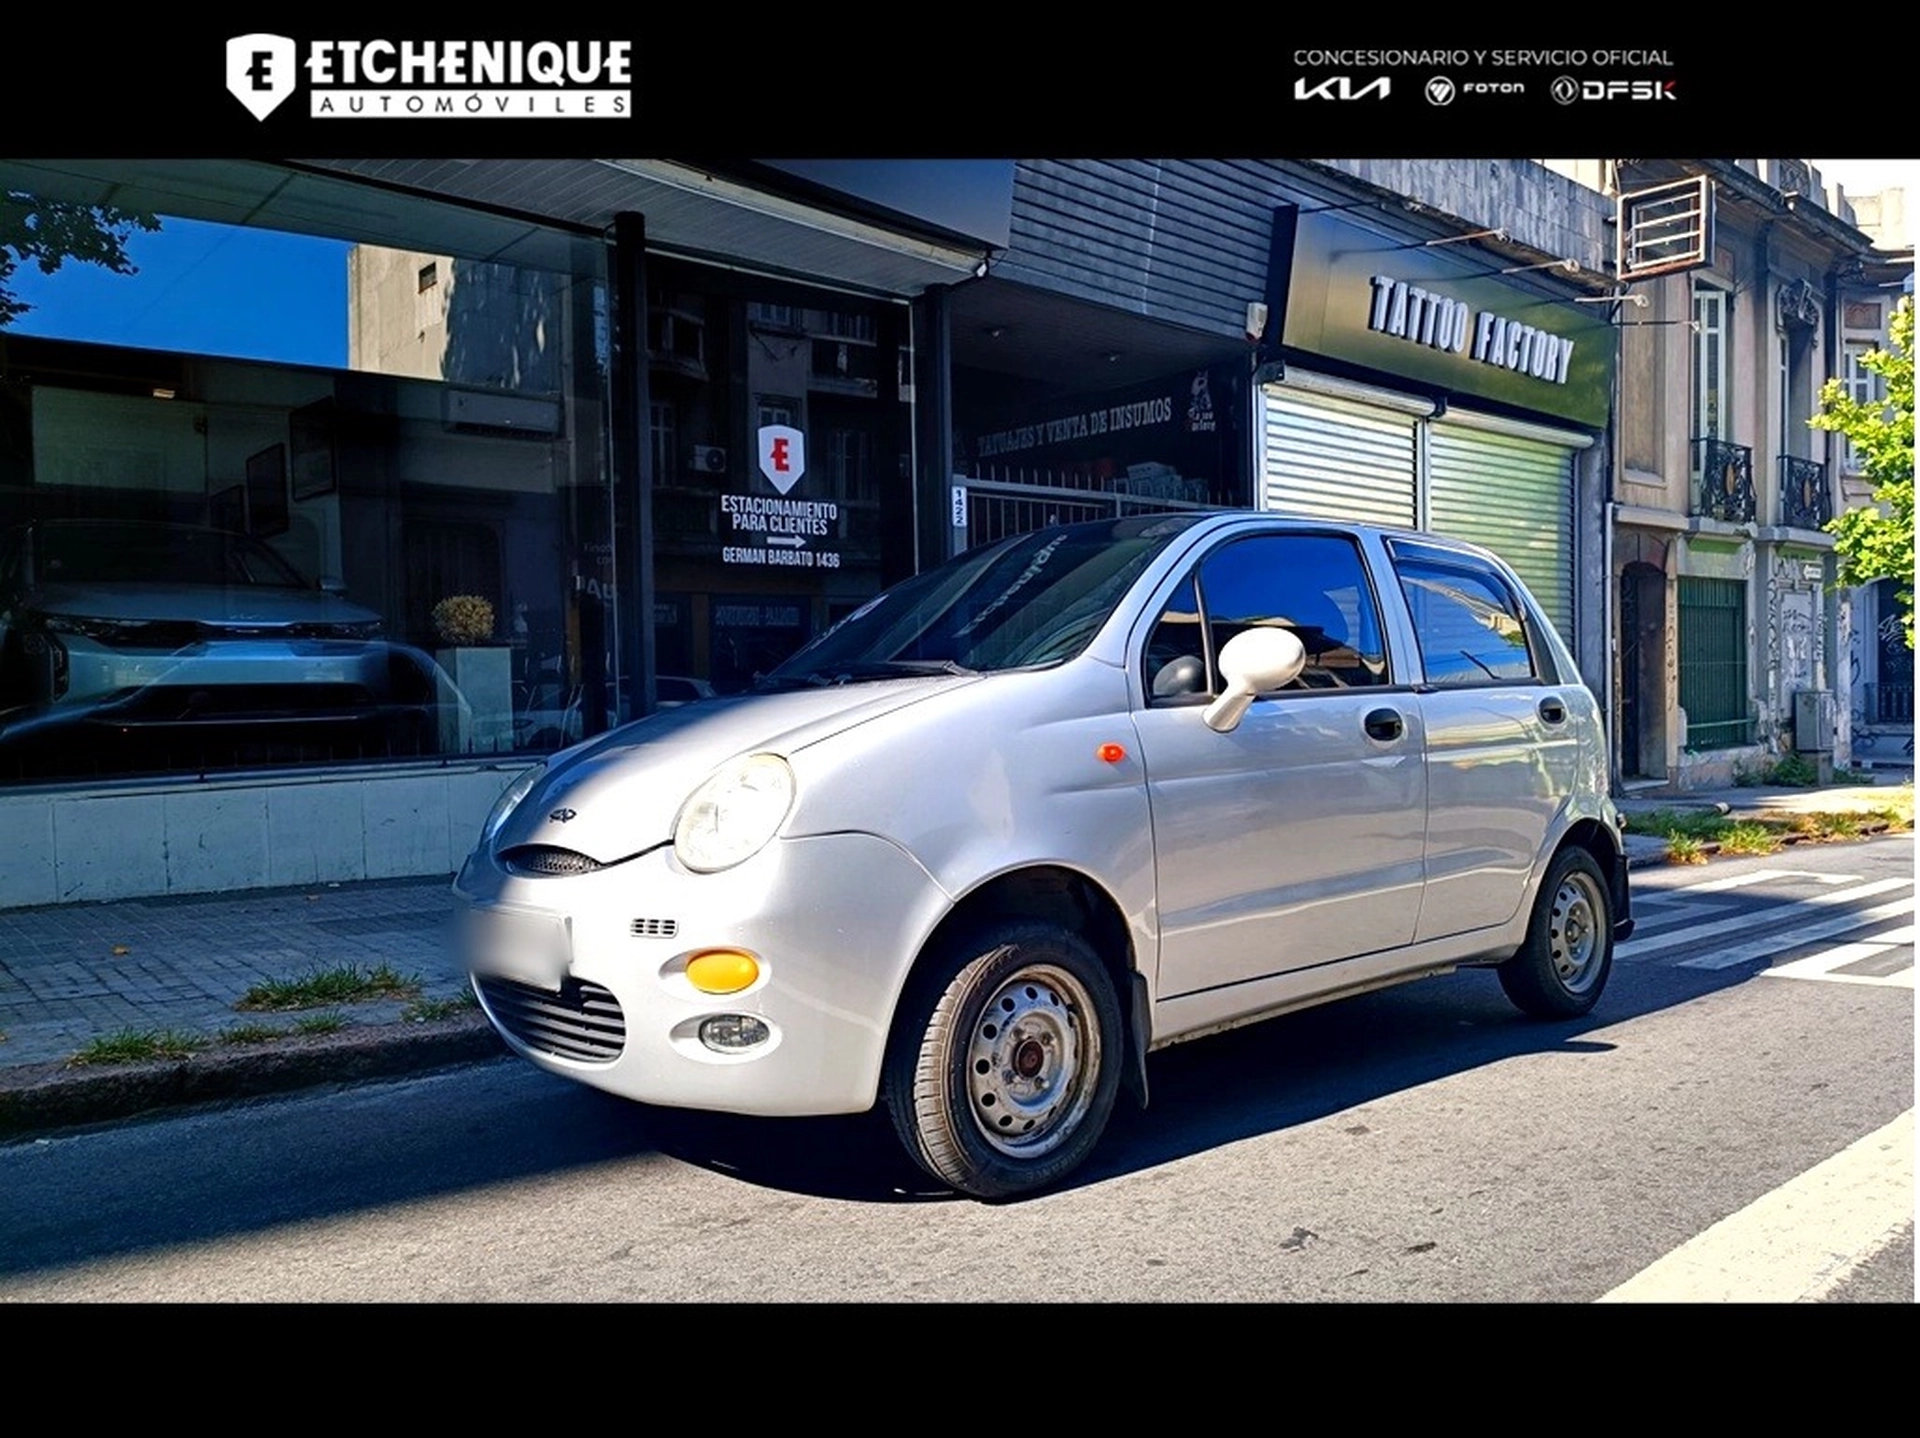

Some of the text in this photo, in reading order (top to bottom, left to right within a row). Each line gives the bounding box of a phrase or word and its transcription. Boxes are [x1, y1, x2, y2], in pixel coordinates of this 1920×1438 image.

[1369, 275, 1575, 384] TATTOO FACTORY
[1046, 413, 1089, 443] VENTA
[1090, 408, 1108, 436] DE
[1109, 396, 1172, 432] INSUMOS
[721, 495, 838, 520] ESTACIONAMIENTO
[732, 513, 828, 535] PARA CLIENTES
[722, 546, 840, 568] GERMAN BARBATO 1436
